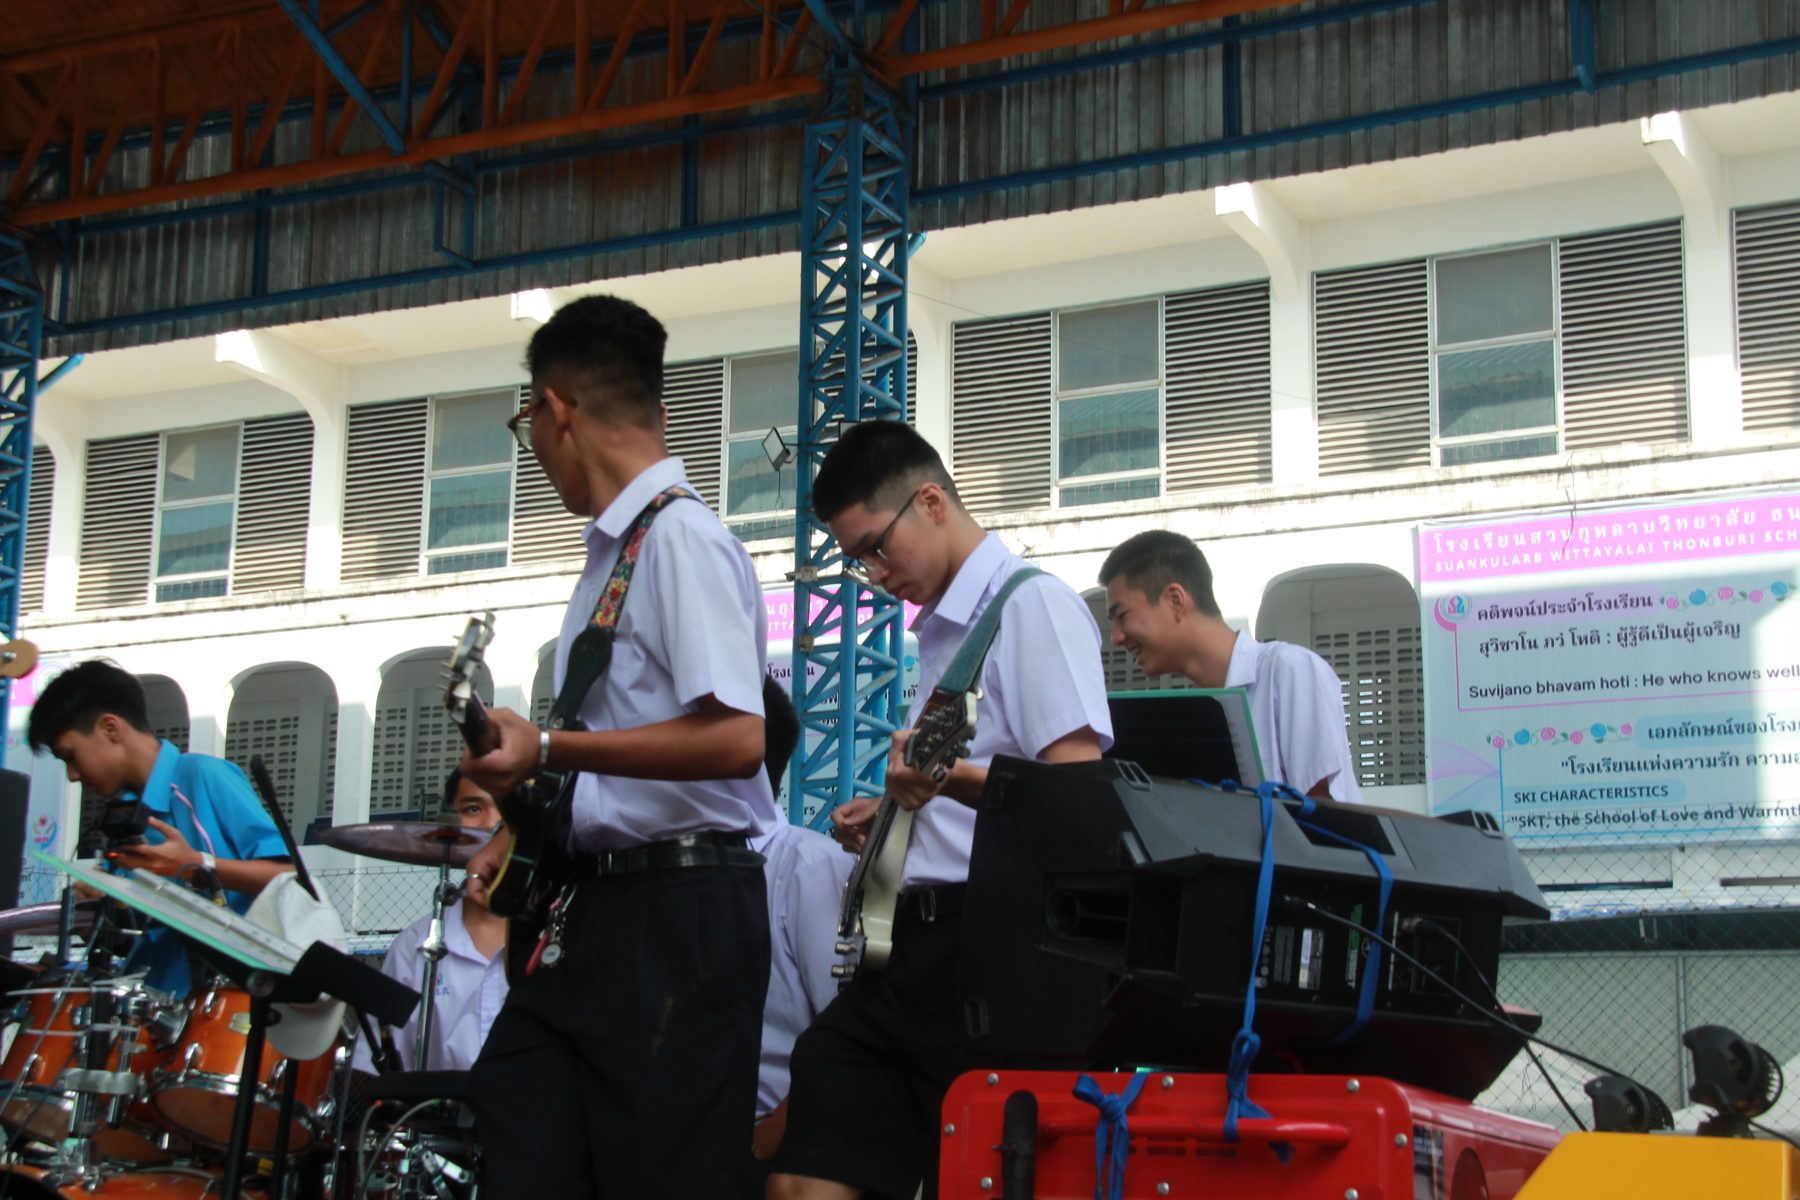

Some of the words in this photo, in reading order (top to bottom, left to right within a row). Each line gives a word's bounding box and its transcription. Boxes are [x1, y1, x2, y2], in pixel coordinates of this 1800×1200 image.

[1435, 552, 1542, 573] SUANKULARB
[1550, 541, 1655, 561] WITTAYALAI
[1662, 533, 1756, 553] THONBURI
[1469, 684, 1532, 699] Suvijano
[1536, 678, 1596, 694] bhavam
[1600, 675, 1630, 689] hoti
[1643, 673, 1665, 687] He
[1669, 671, 1703, 685] who
[1707, 669, 1761, 683] knows
[1648, 713, 1800, 739] เอกลักษณ์ของโรง
[1540, 785, 1669, 803] CHARACTERISTICS
[1554, 812, 1581, 827] the
[1584, 809, 1636, 825] School
[1640, 808, 1657, 822] of
[1661, 808, 1699, 822] Love
[1703, 804, 1734, 820] and
